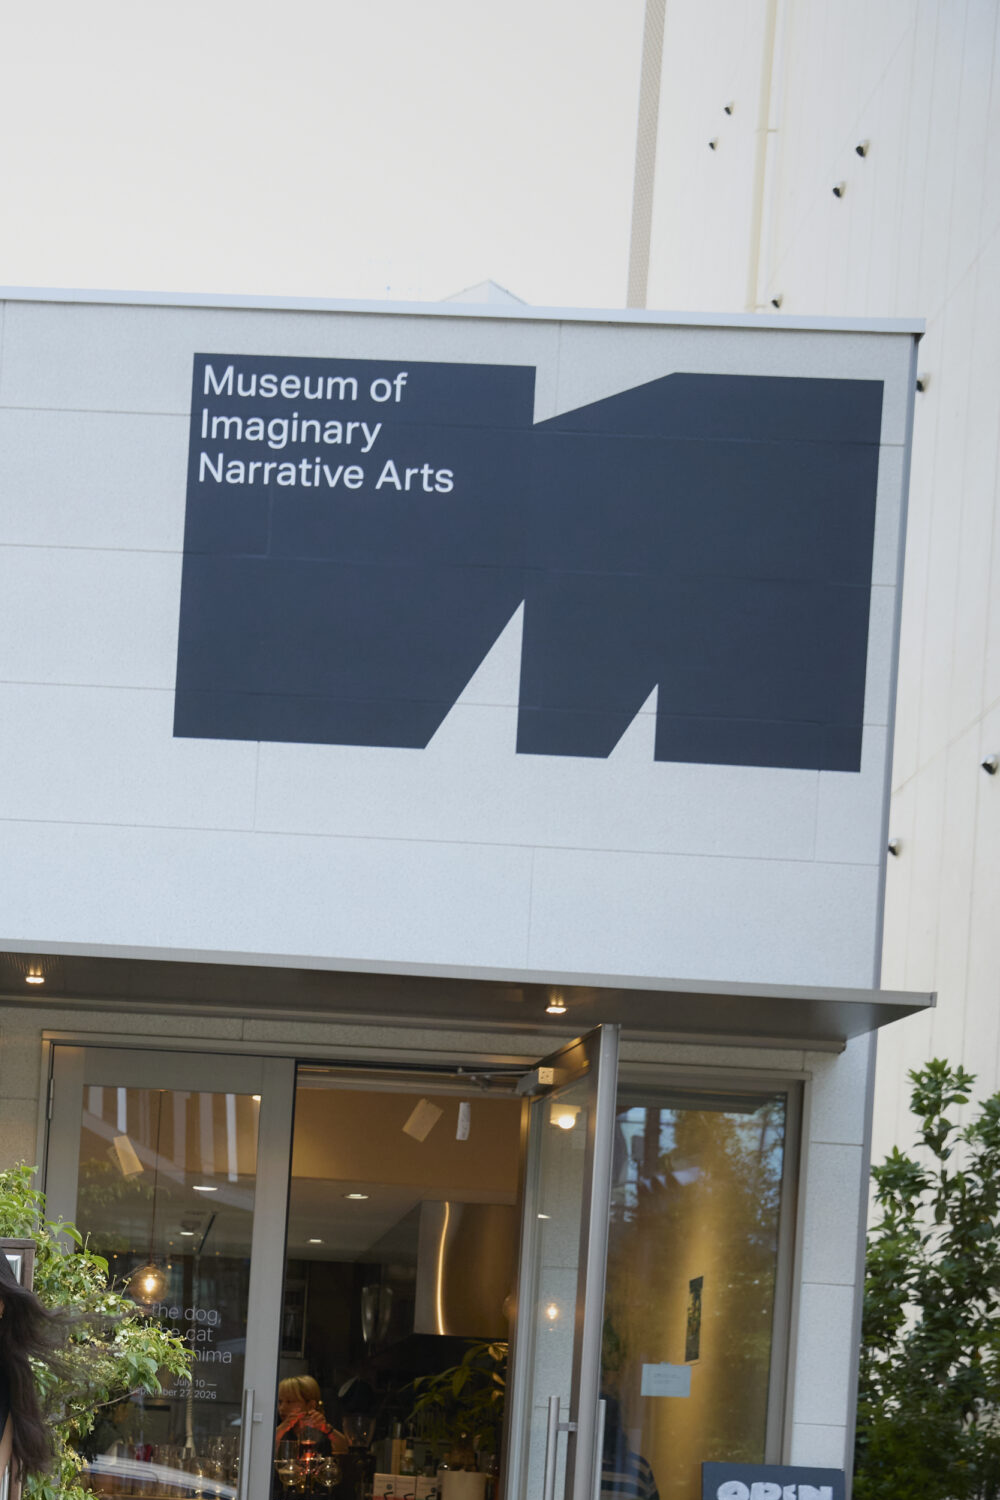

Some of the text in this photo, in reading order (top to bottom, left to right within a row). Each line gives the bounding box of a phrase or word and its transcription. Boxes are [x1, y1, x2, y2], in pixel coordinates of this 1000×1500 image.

[203, 364, 408, 402] Museum of
[200, 408, 382, 453] Imaginary
[199, 452, 454, 493] Narrative Arts
[152, 1302, 221, 1326] the dog,
[186, 1327, 214, 1342] cat
[194, 1390, 217, 1400] 2026
[195, 1379, 206, 1388] 10
